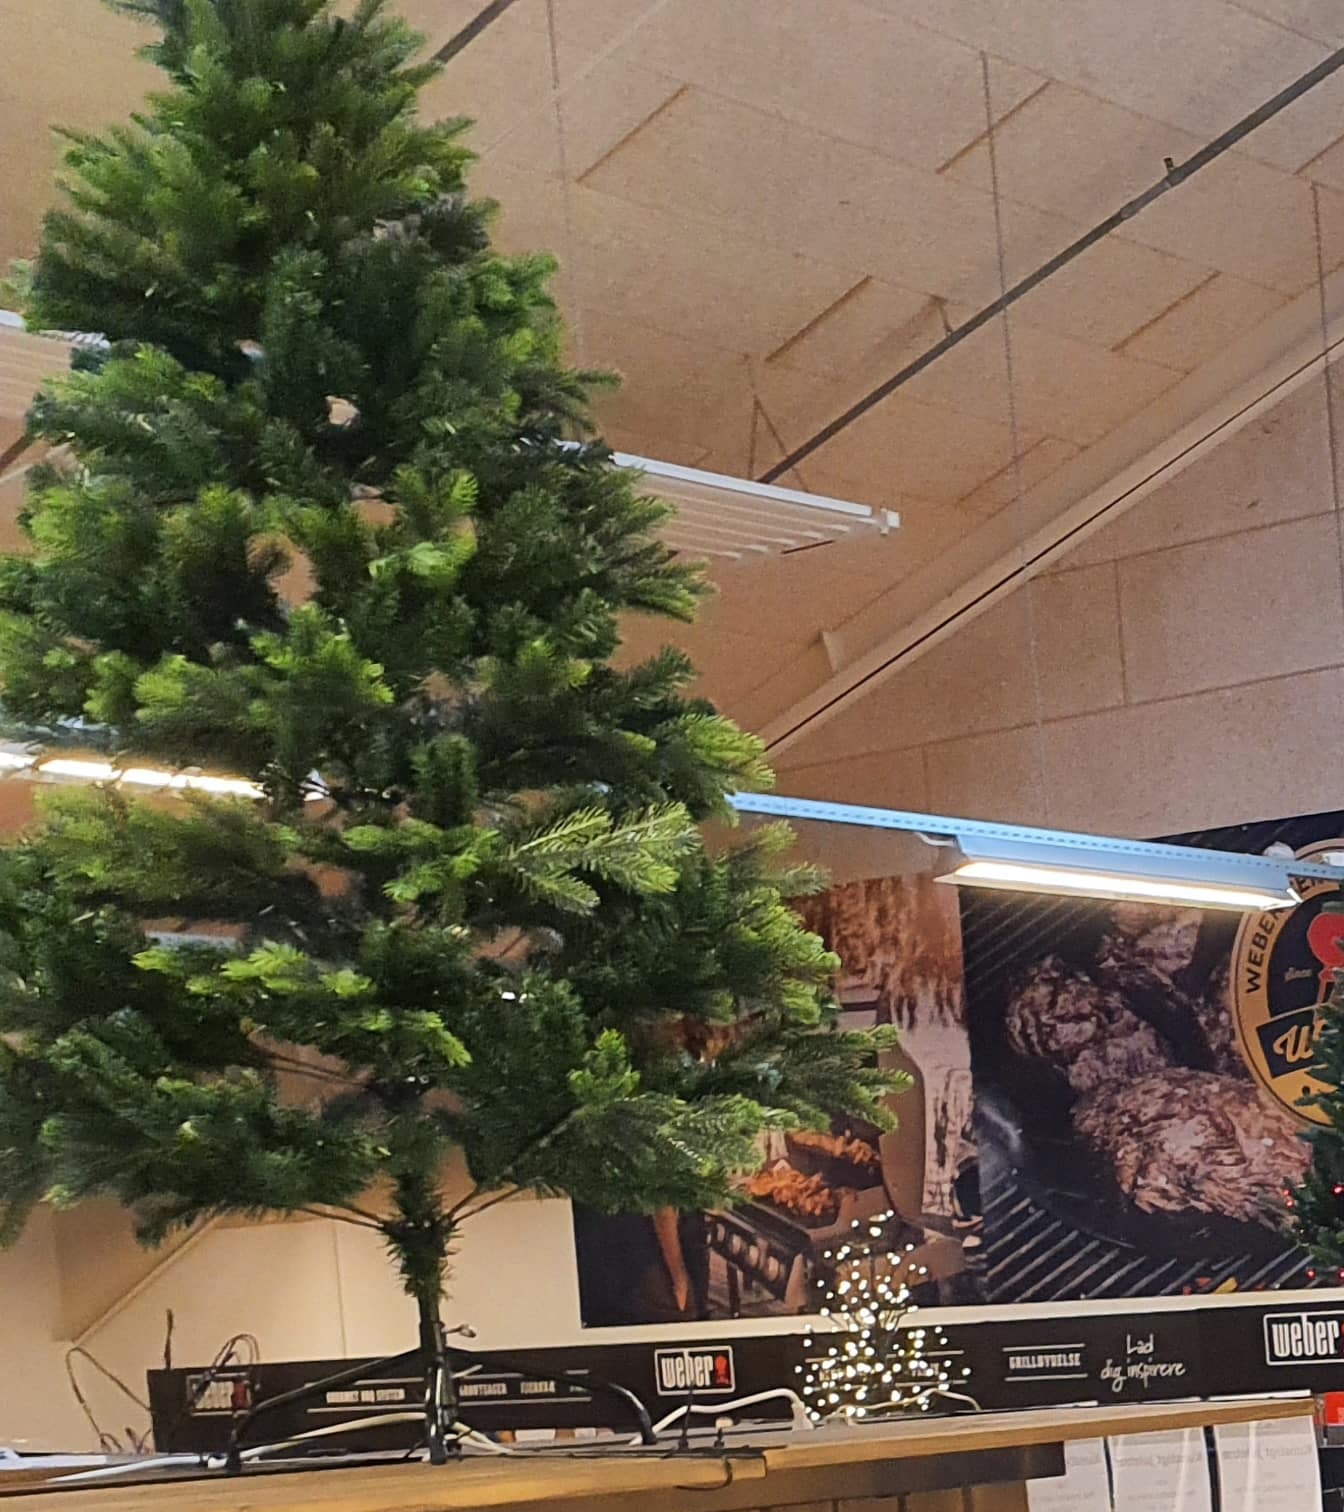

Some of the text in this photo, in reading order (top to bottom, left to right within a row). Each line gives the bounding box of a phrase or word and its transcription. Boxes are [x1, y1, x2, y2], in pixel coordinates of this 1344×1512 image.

[1126, 1334, 1154, 1356] Lad
[1271, 1315, 1341, 1358] weber
[661, 1347, 713, 1388] weber
[1100, 1360, 1125, 1393] dig
